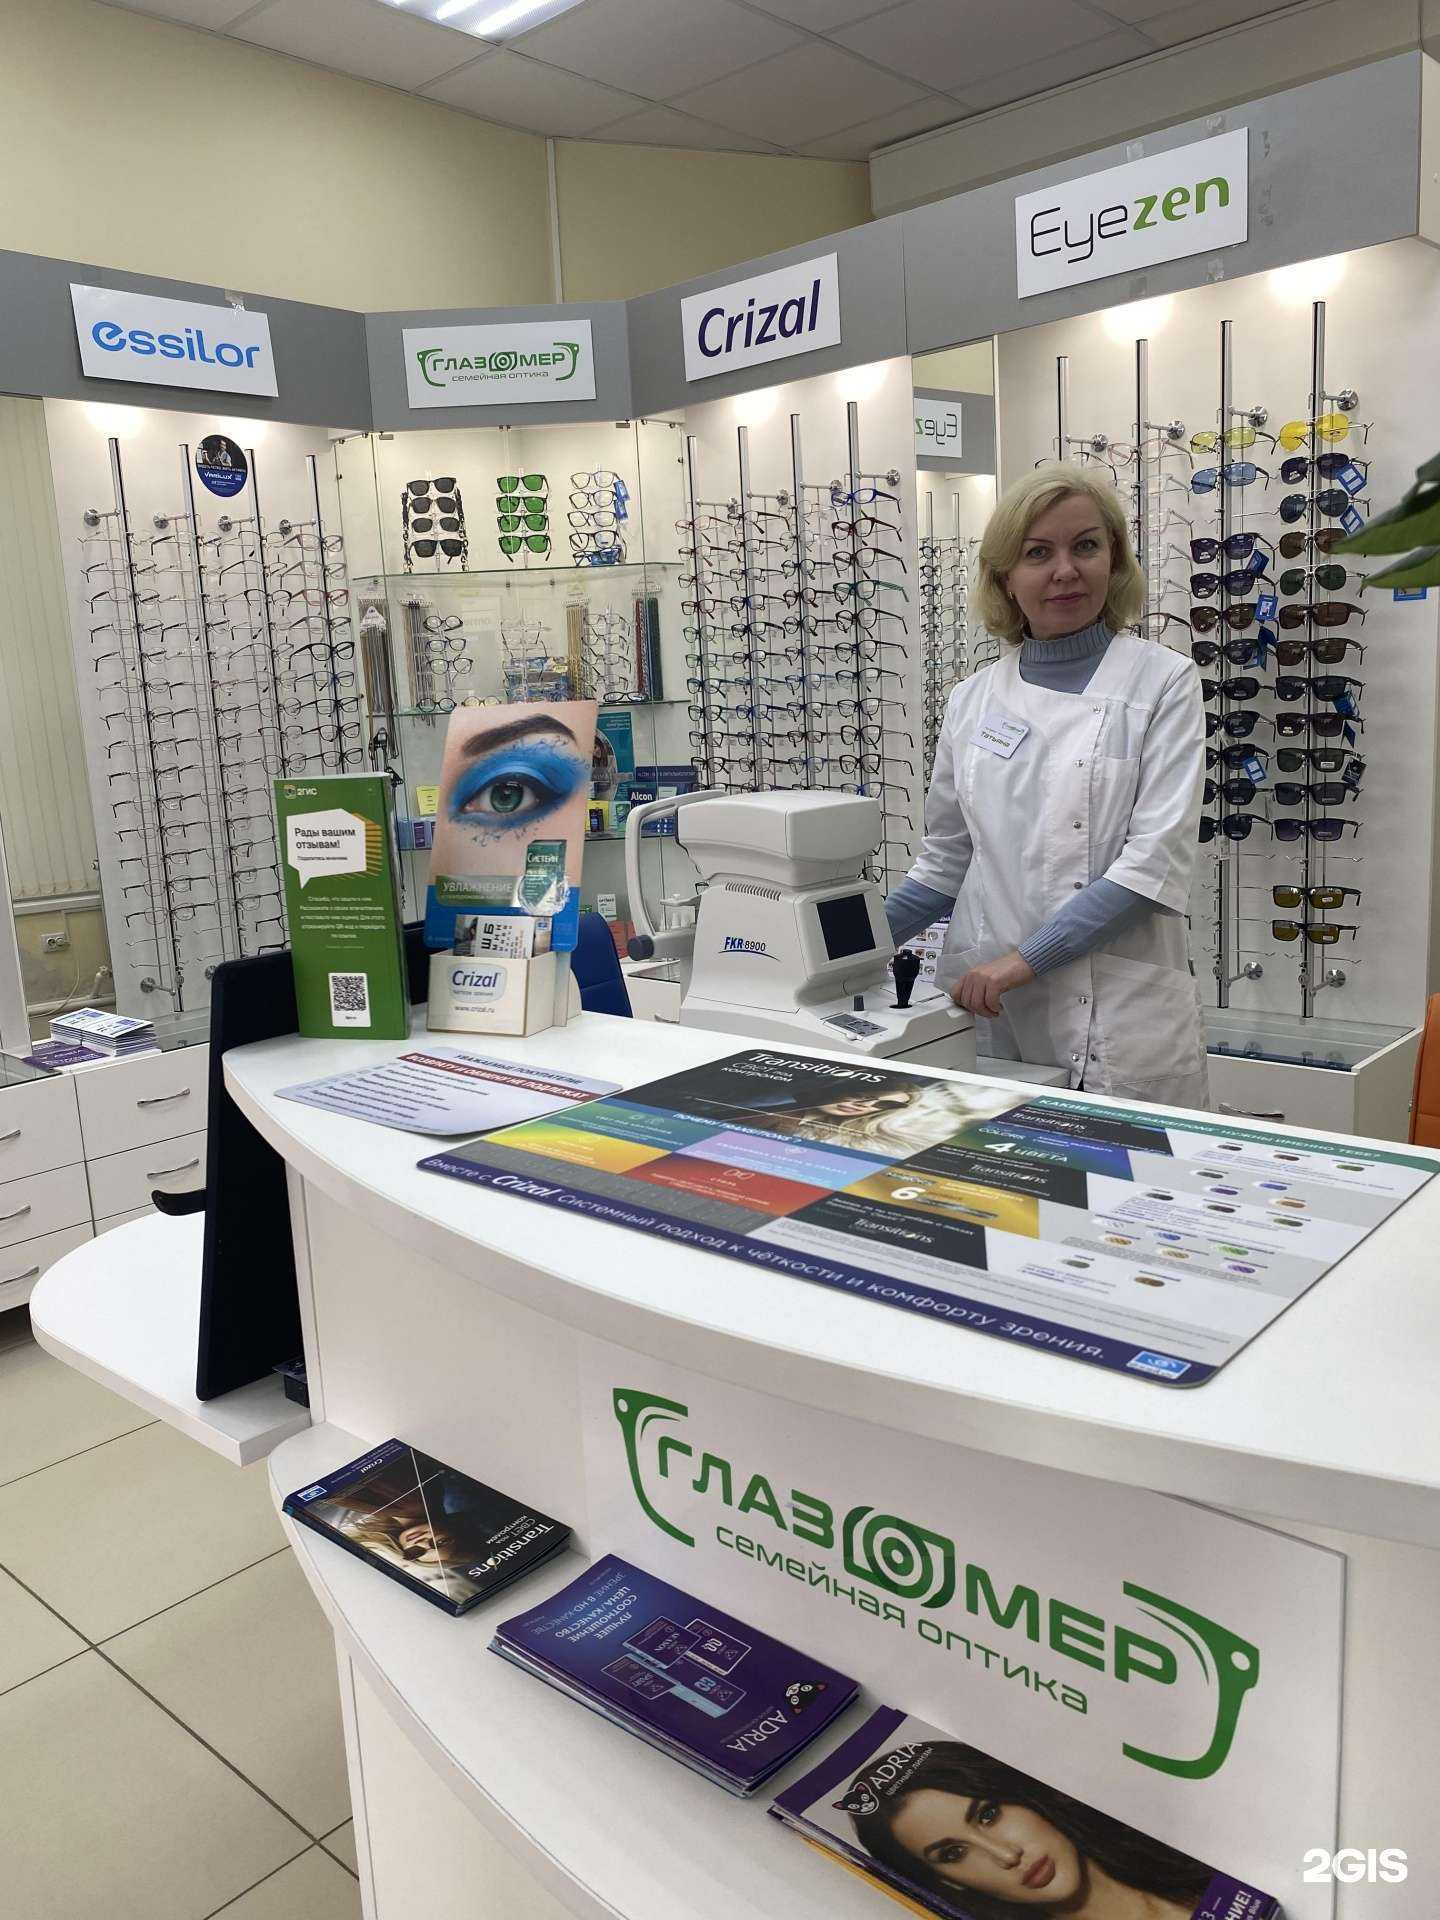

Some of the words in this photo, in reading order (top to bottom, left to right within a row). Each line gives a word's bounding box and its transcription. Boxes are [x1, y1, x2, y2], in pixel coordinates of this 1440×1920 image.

[1030, 175, 1229, 263] Eyezen
[698, 278, 821, 358] Crizal
[91, 320, 260, 369] essilor
[451, 370, 506, 382] семейная
[507, 369, 549, 381] оптика
[630, 791, 653, 801] Alcon
[294, 828, 320, 838] Рады
[322, 827, 356, 837] вашим
[296, 840, 341, 849] отзывам!
[452, 970, 498, 987] Crizal
[748, 1052, 888, 1083] Transitions
[983, 1142, 1016, 1154] 4
[890, 1186, 926, 1200] 6
[492, 1173, 555, 1201] Crizal
[557, 1193, 658, 1227] Системный
[657, 1221, 726, 1249] подход
[846, 1276, 863, 1288] и
[866, 1281, 997, 1327] комфорту
[998, 1320, 1107, 1360] зрения.
[467, 1523, 554, 1578] Transitions
[657, 1435, 1178, 1686] ГЛАЗОМЕР
[568, 1593, 639, 1643] СООТНОШЕНИЕ
[594, 1612, 633, 1640] ЛУЧШЕЕ
[716, 1524, 906, 1628] семейная
[918, 1625, 1089, 1715] оптика
[725, 1709, 789, 1752] ADRIA
[869, 1741, 923, 1790] ADRIA
